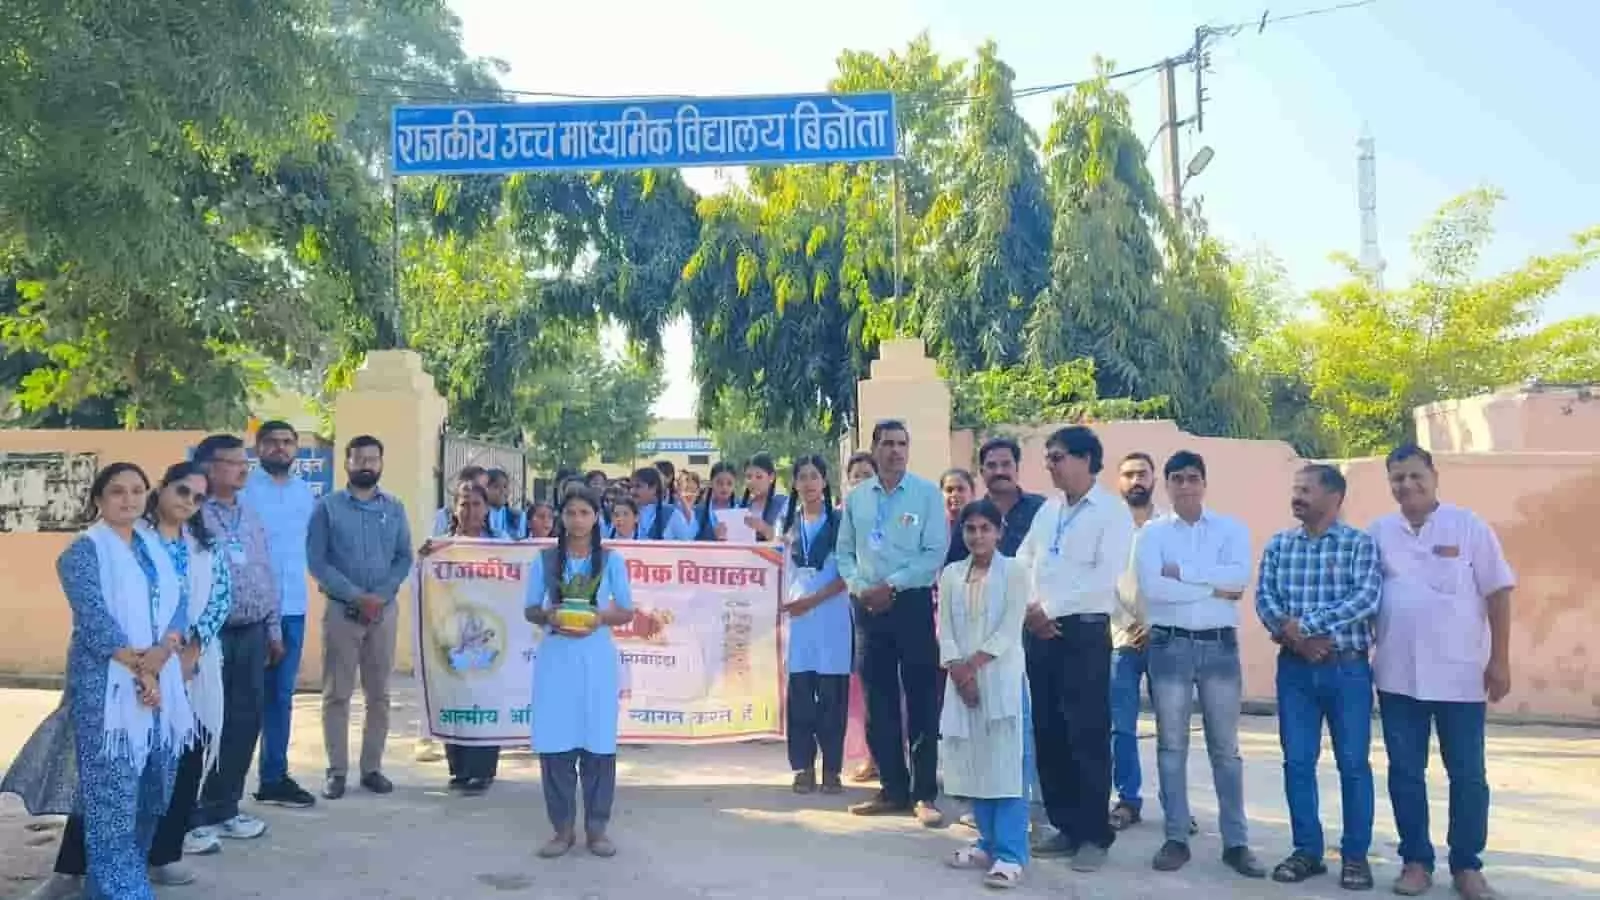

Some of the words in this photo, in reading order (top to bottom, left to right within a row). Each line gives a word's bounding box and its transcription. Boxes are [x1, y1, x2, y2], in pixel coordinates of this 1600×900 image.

[397, 109, 498, 164] राजकीय
[501, 122, 556, 160] उच्च
[559, 106, 673, 159] माध्यमिक
[674, 103, 787, 155] विद्यालय
[789, 97, 889, 153] बिनोता
[432, 557, 521, 581] राजकीय
[678, 559, 768, 587] विद्यालय
